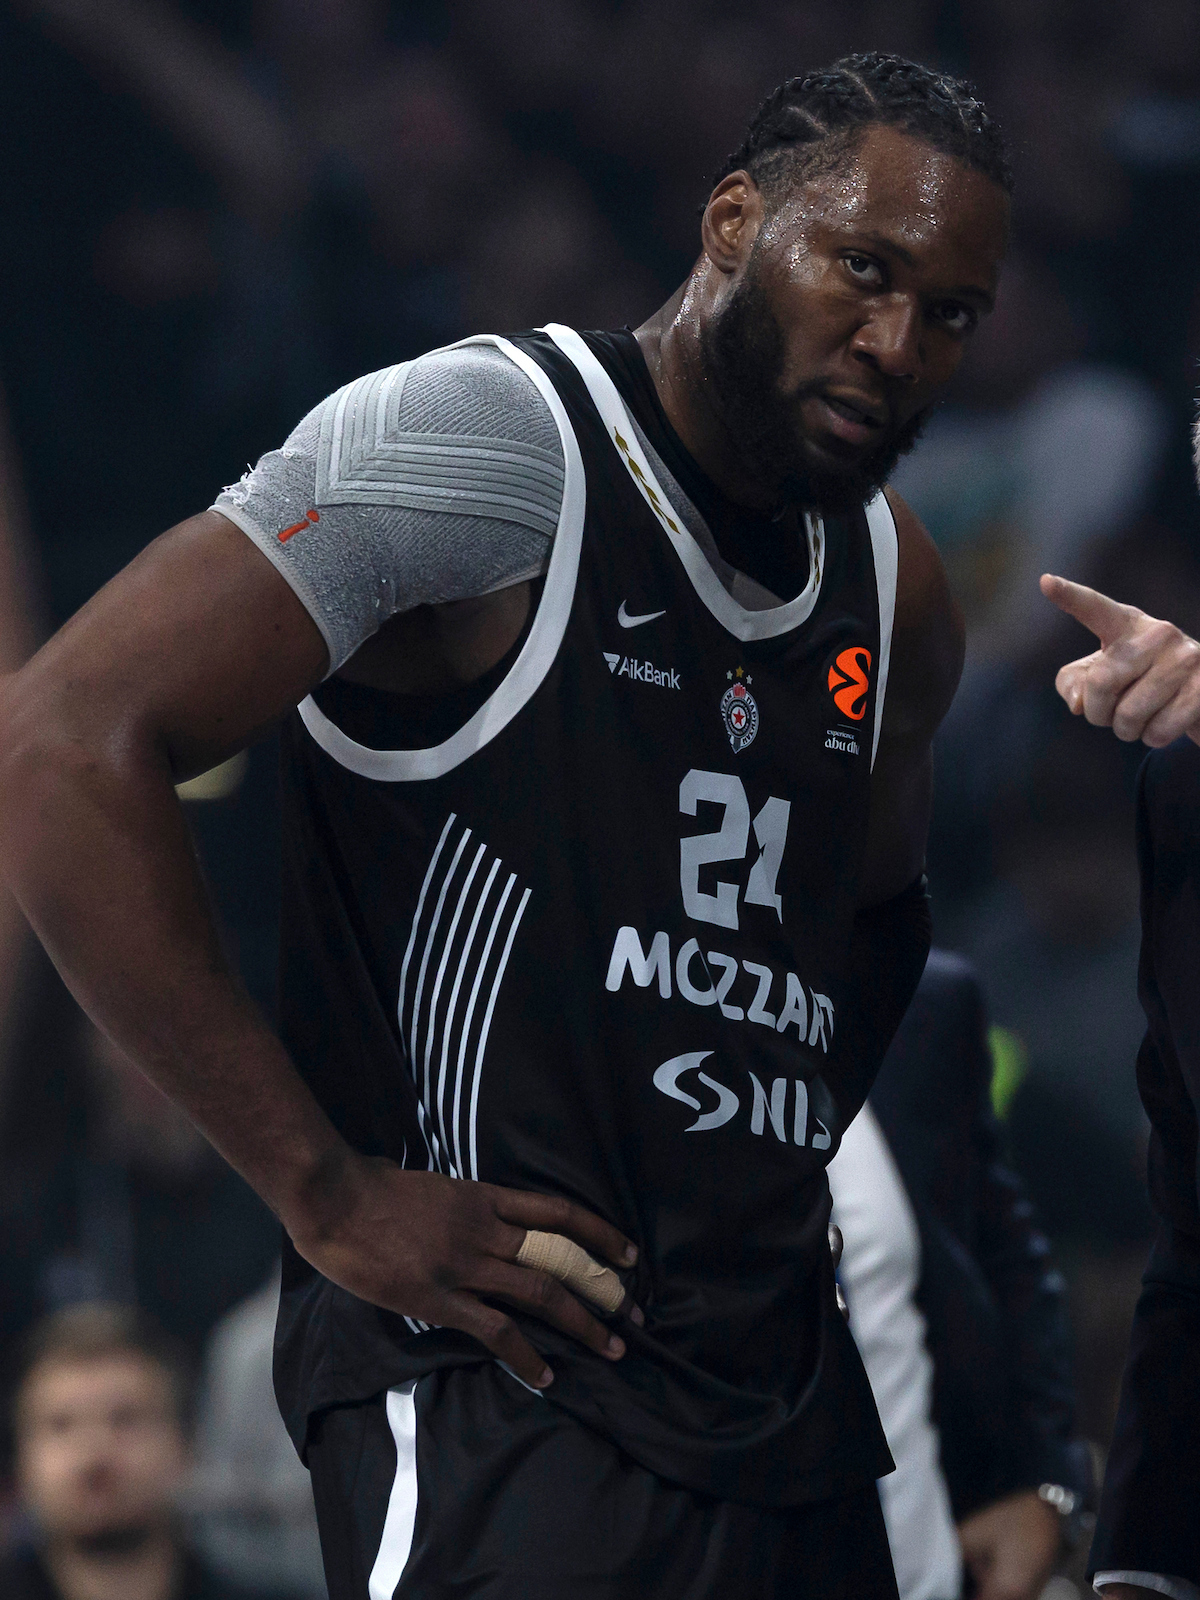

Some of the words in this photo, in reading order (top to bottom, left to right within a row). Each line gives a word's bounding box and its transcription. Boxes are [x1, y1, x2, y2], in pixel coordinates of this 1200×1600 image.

[618, 656, 681, 690] AikBank
[824, 737, 846, 752] abu
[679, 769, 791, 930] 21
